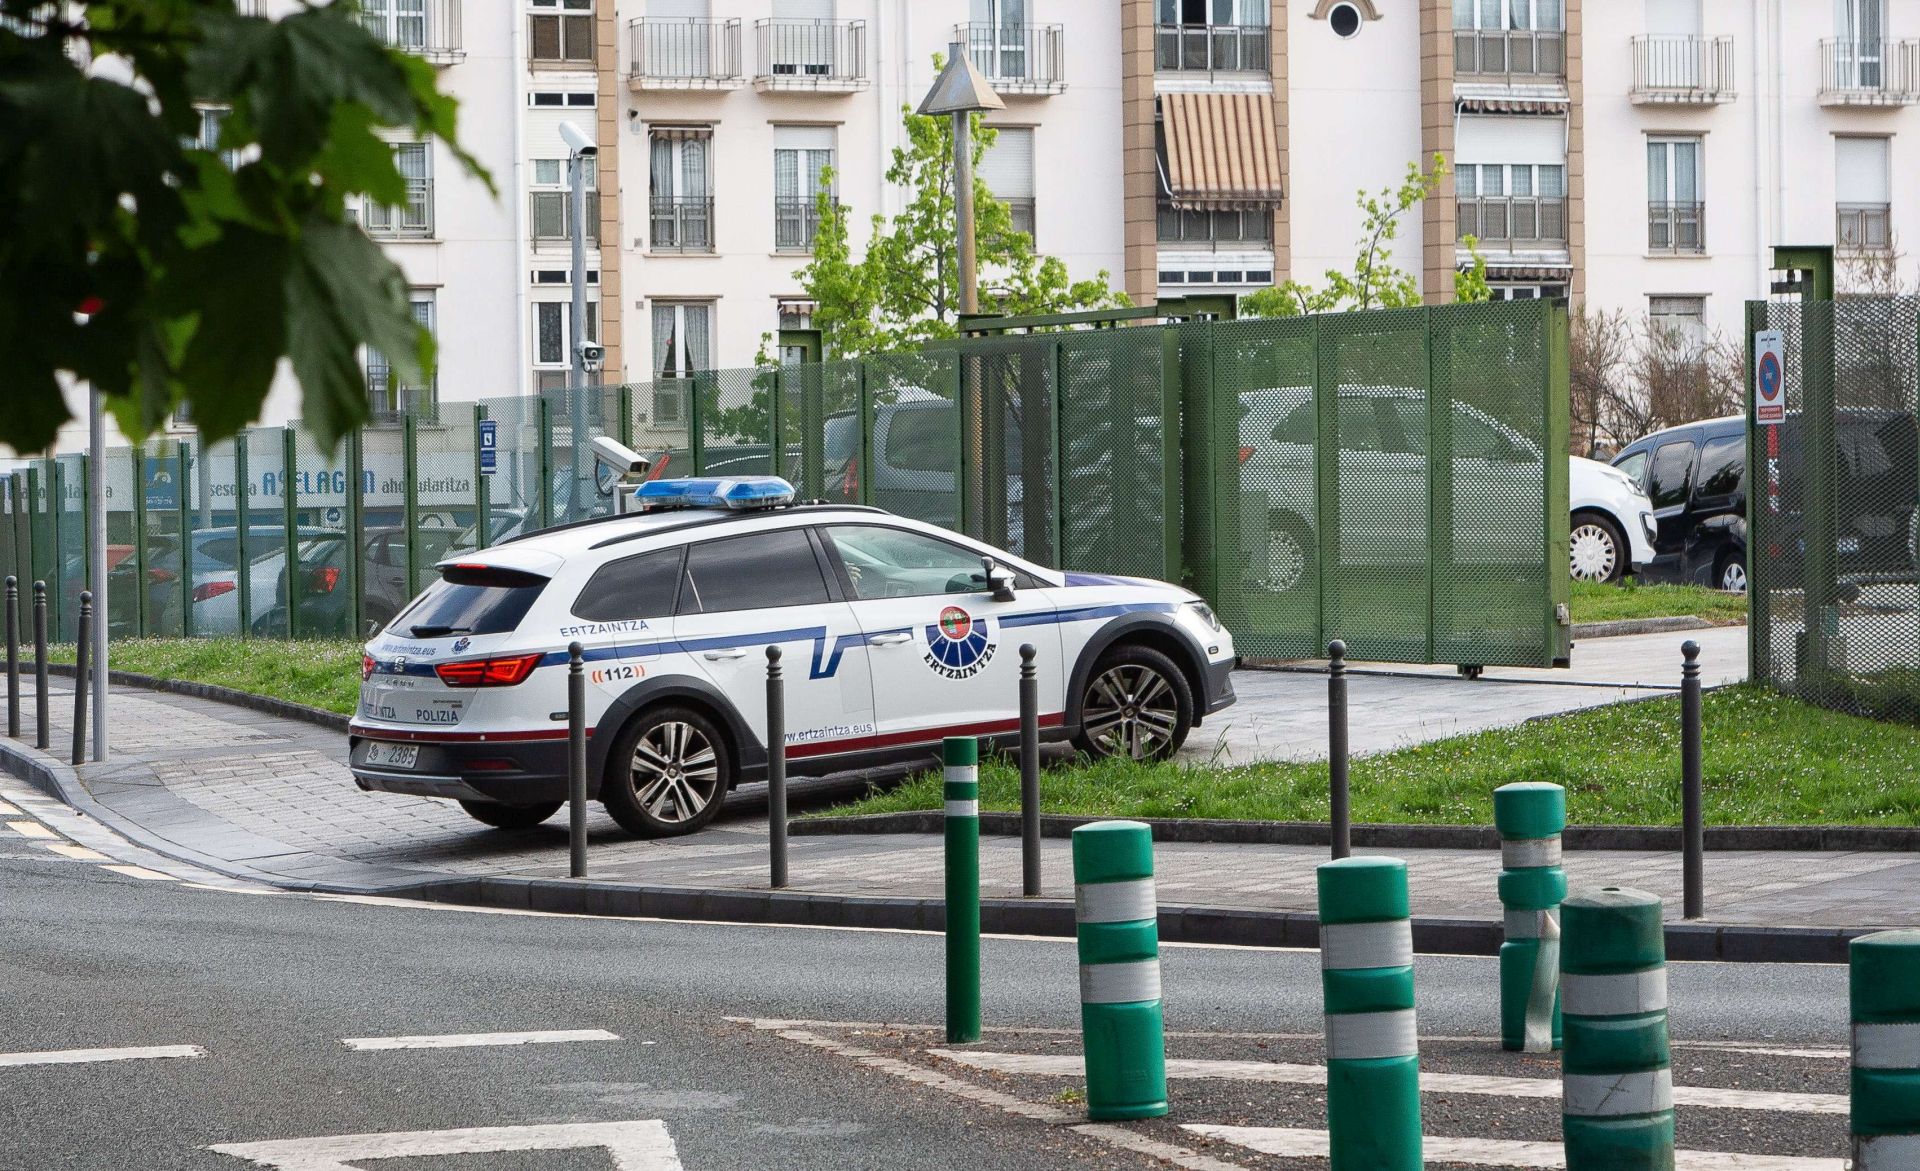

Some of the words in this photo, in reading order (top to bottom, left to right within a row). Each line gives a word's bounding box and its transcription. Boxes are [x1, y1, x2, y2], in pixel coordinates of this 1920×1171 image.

[382, 477, 469, 494] ahoularitza
[560, 620, 649, 637] ERTZAINTZA
[923, 643, 997, 679] ERTZAINTZA
[416, 708, 459, 722] POLIZIA
